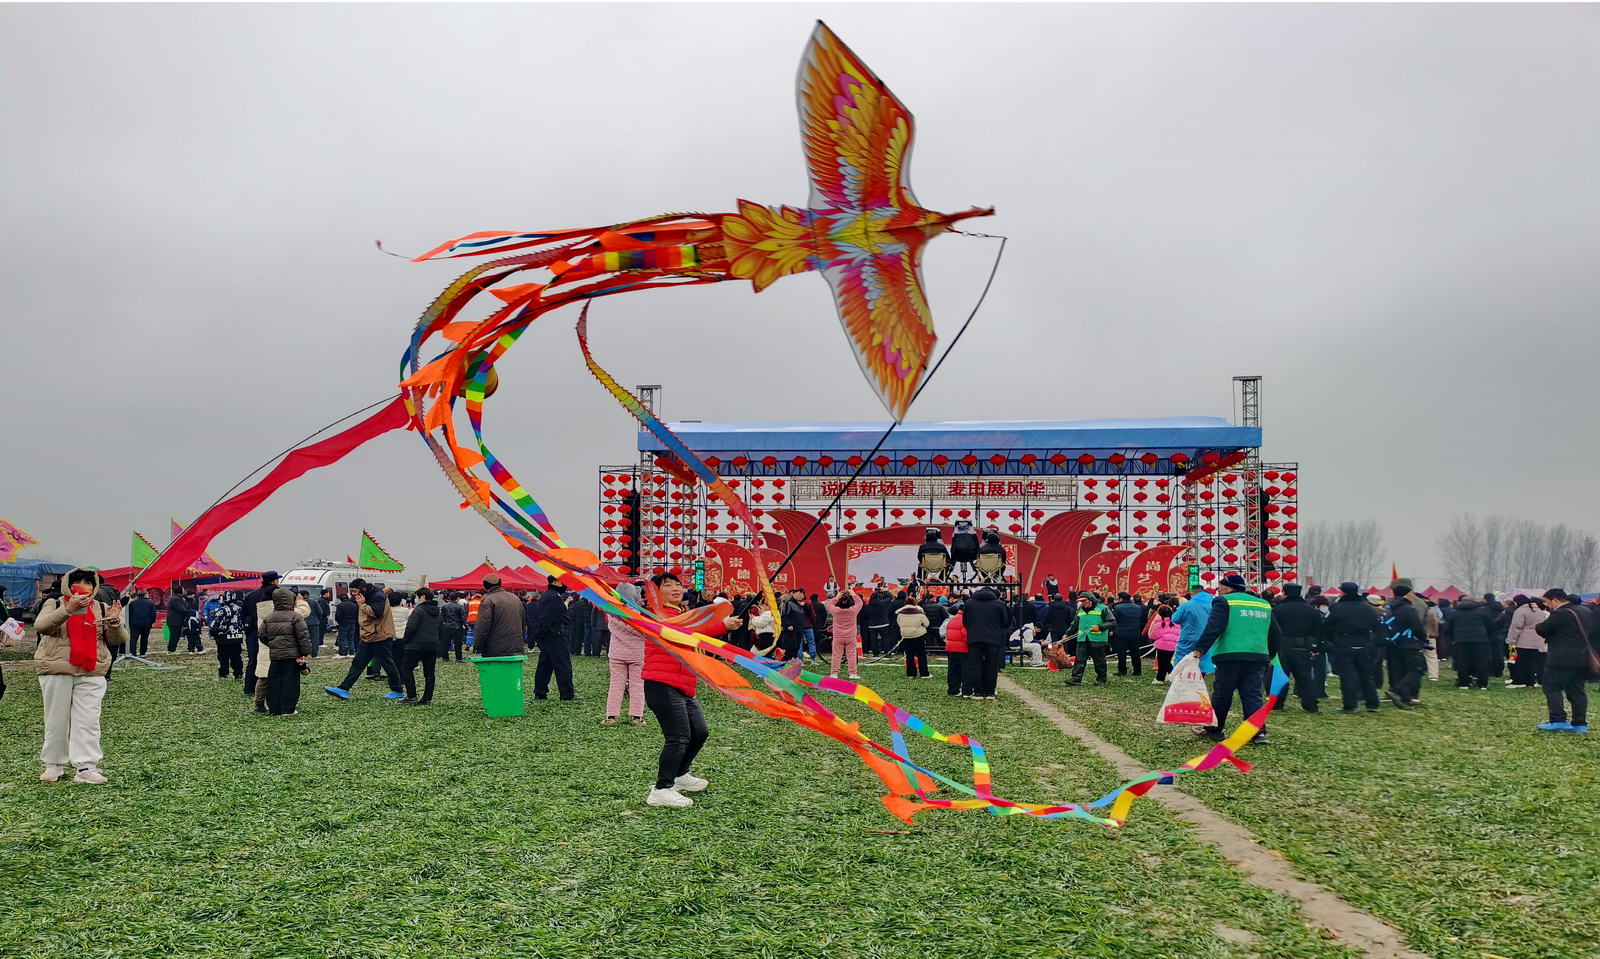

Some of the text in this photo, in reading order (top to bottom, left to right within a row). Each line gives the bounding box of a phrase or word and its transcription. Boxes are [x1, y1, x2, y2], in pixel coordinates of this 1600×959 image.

[820, 480, 1046, 497] 说唱新场景 麦田展风华
[1088, 563, 1110, 586] 为民
[1137, 561, 1161, 584] 尚艺
